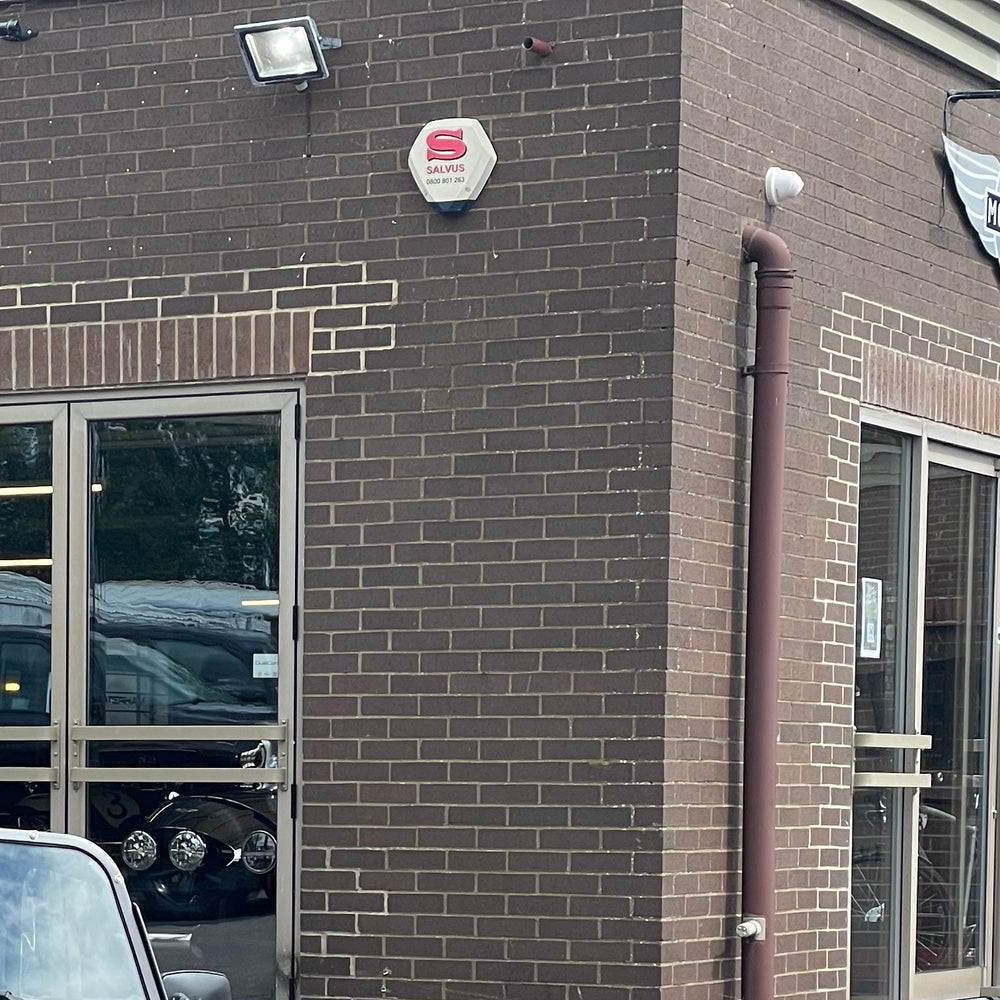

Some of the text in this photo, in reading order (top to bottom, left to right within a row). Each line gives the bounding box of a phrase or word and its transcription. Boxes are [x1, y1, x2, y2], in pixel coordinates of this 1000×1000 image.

[426, 128, 468, 162] S
[426, 164, 465, 175] SALVUS
[988, 197, 1000, 228] M
